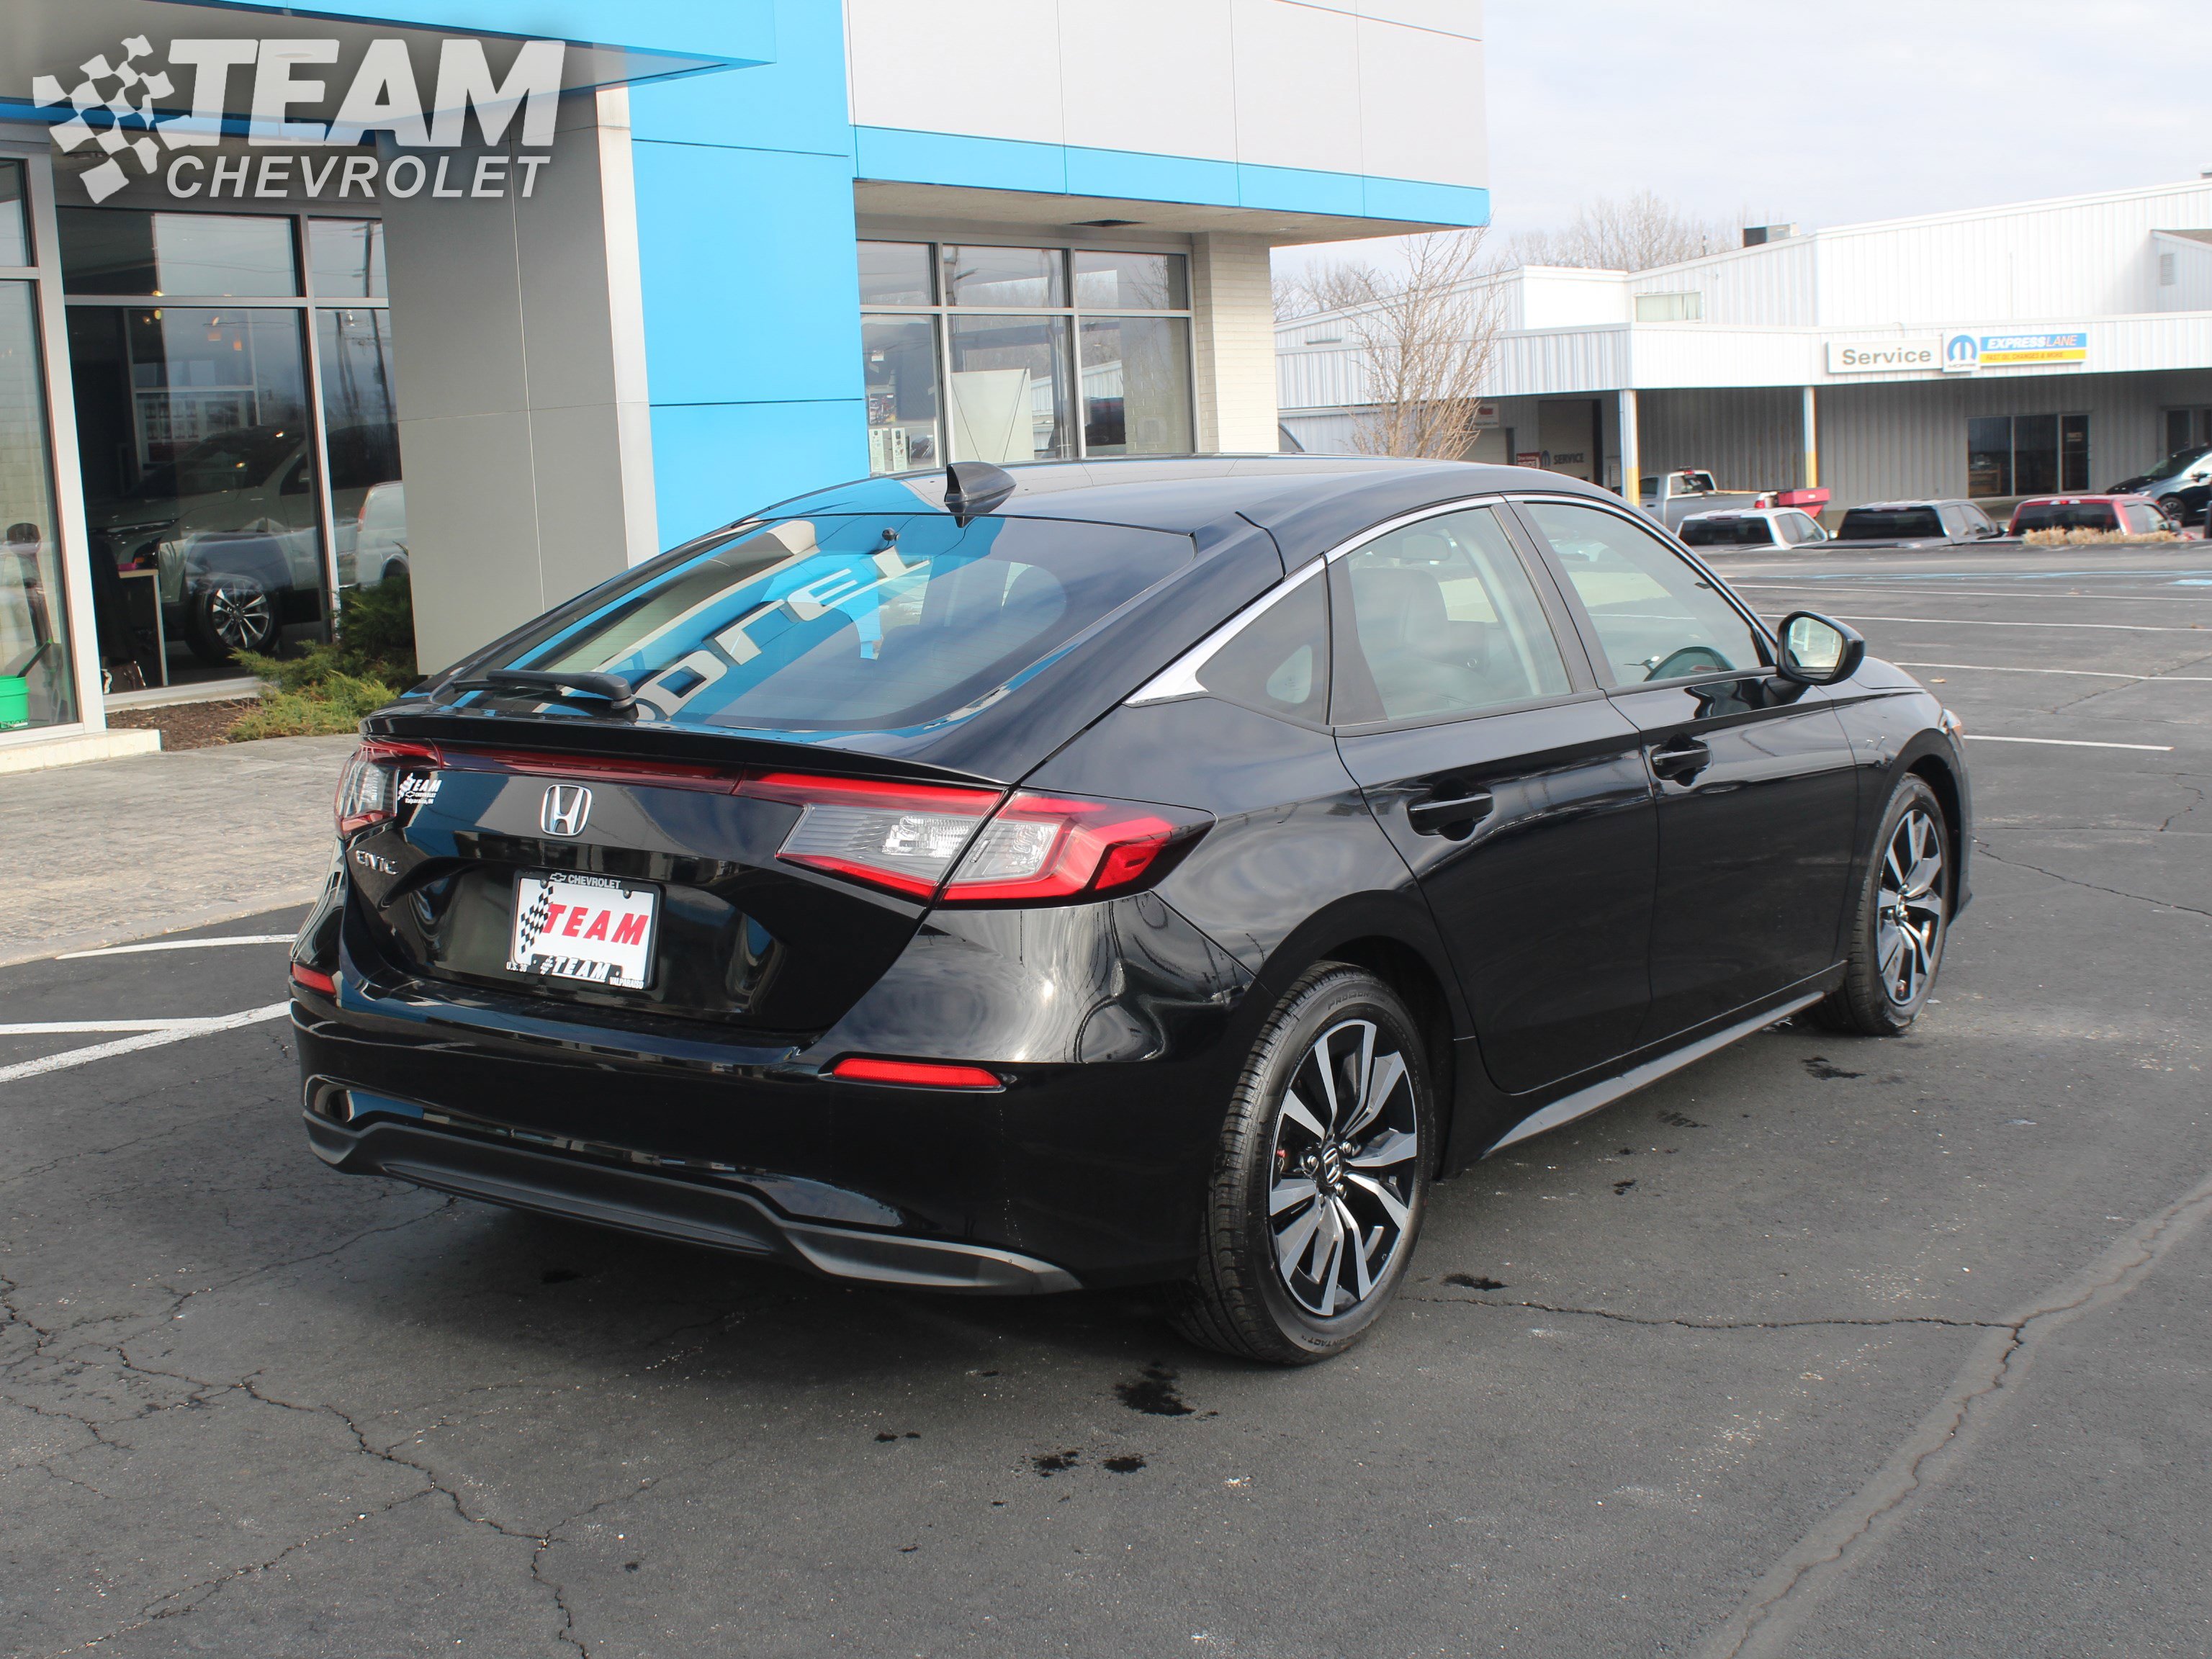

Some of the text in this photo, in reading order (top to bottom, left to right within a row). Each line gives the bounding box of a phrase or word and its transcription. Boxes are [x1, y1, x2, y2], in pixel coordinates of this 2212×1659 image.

[1842, 347, 1931, 366] Service
[1554, 452, 1584, 465] SERVICE
[408, 779, 442, 791] TEAM
[355, 850, 399, 876] CIVIC
[567, 874, 621, 889] CHEVROLET
[542, 903, 649, 946] TEAM
[505, 961, 518, 971] U.S.
[553, 955, 611, 980] TEAM
[608, 976, 644, 989] VALPARAISO
